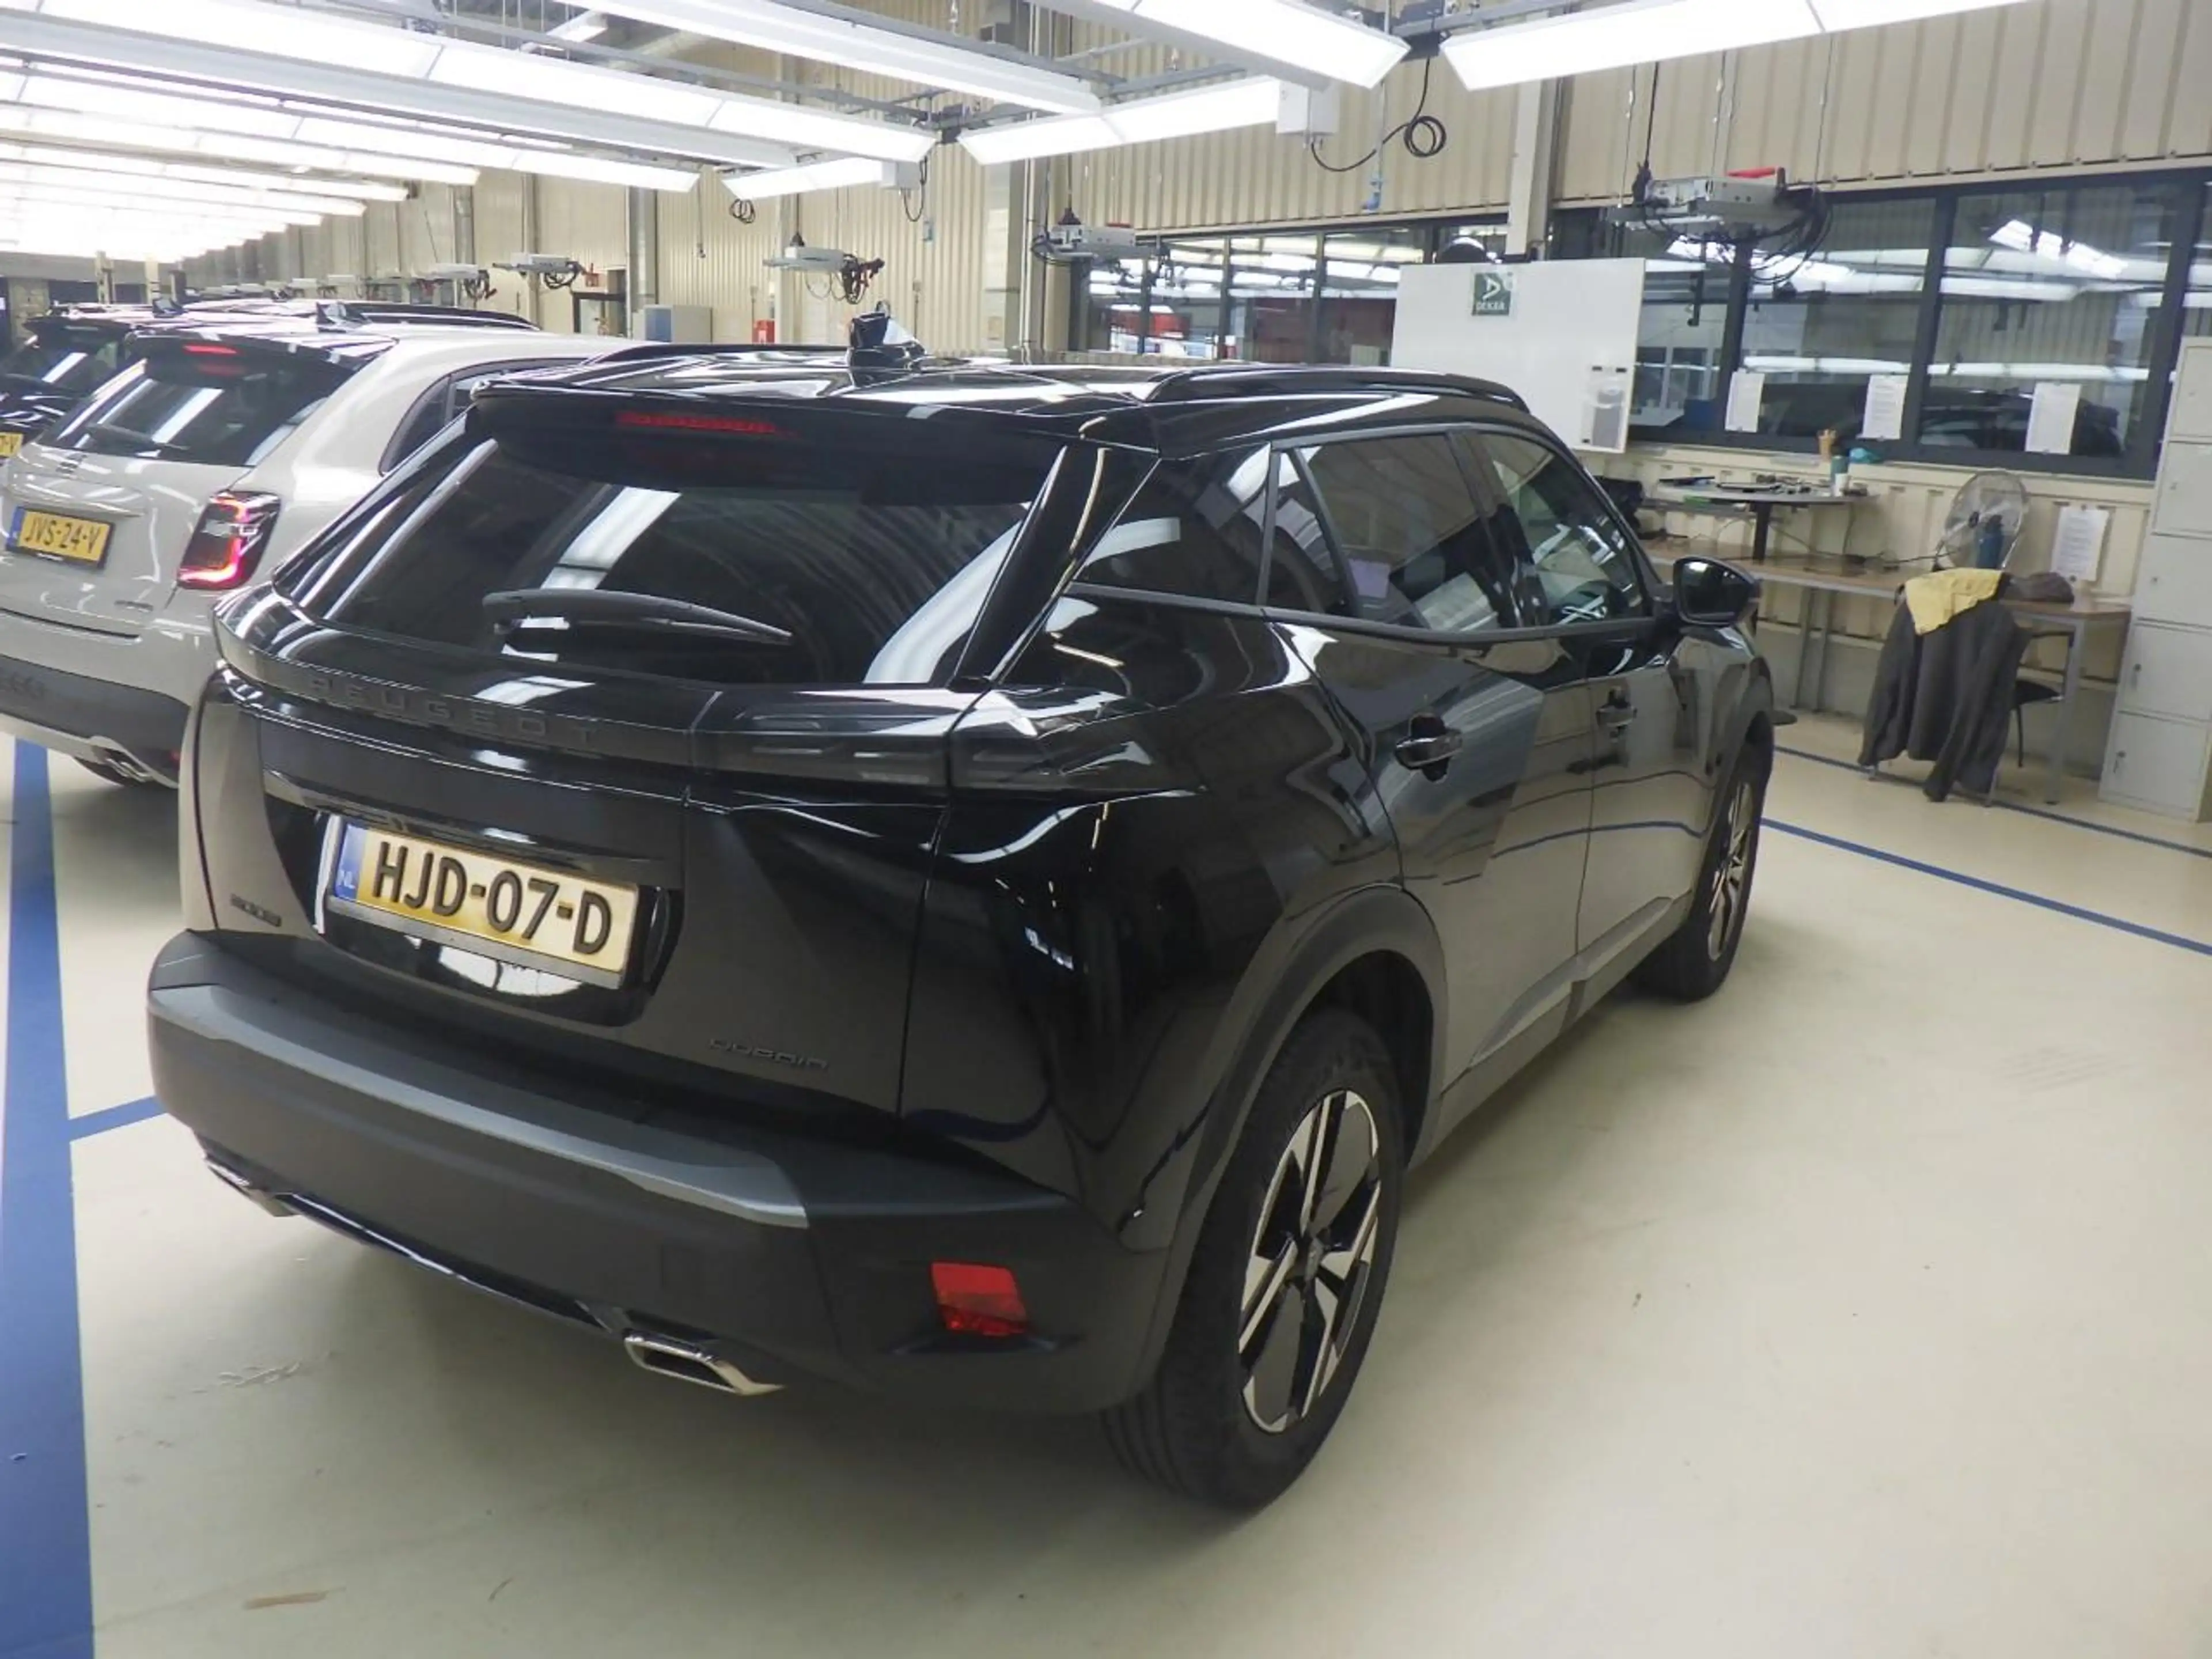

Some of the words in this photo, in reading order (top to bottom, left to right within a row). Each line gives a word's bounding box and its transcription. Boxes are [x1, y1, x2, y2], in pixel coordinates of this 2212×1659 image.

[24, 517, 101, 554] JVS-24-V
[308, 677, 597, 745] PEUGEOT
[338, 868, 357, 890] NL
[372, 840, 612, 955] HJD-07-D
